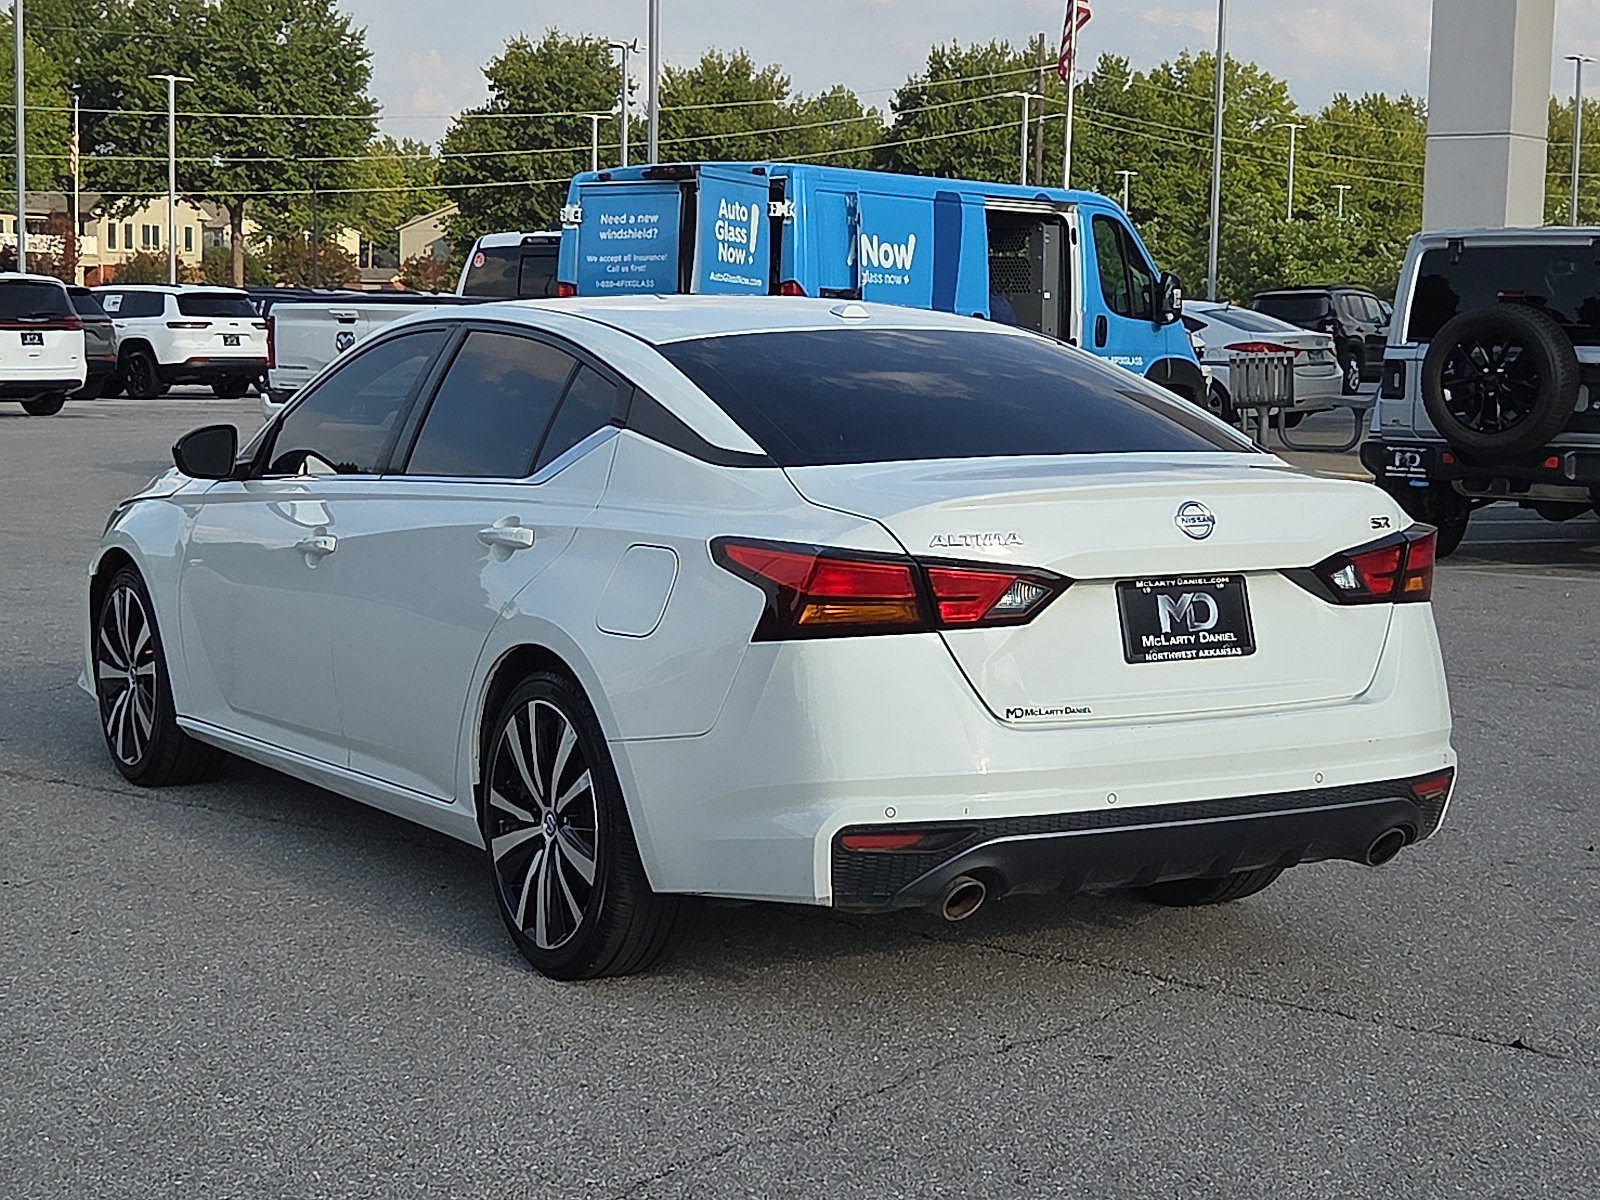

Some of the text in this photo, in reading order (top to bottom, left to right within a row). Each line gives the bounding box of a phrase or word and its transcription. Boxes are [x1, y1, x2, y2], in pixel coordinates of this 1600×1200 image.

[718, 198, 748, 222] Auto
[600, 213, 659, 225] Need a new
[599, 228, 659, 240] windshield?
[714, 220, 748, 244] Glass
[586, 255, 598, 263] We
[599, 254, 622, 264] accept
[623, 253, 632, 262] all
[606, 265, 620, 273] Call
[861, 269, 903, 286] glass now
[1180, 516, 1214, 524] NISSAN
[1370, 516, 1391, 529] SR
[928, 532, 1024, 548] ALTIMA
[1156, 591, 1219, 634] MD
[1141, 631, 1238, 648] McLARTY DANIEL
[1145, 647, 1242, 661] NORTHWEST ARKANSAS
[1064, 706, 1092, 715] DANIEL
